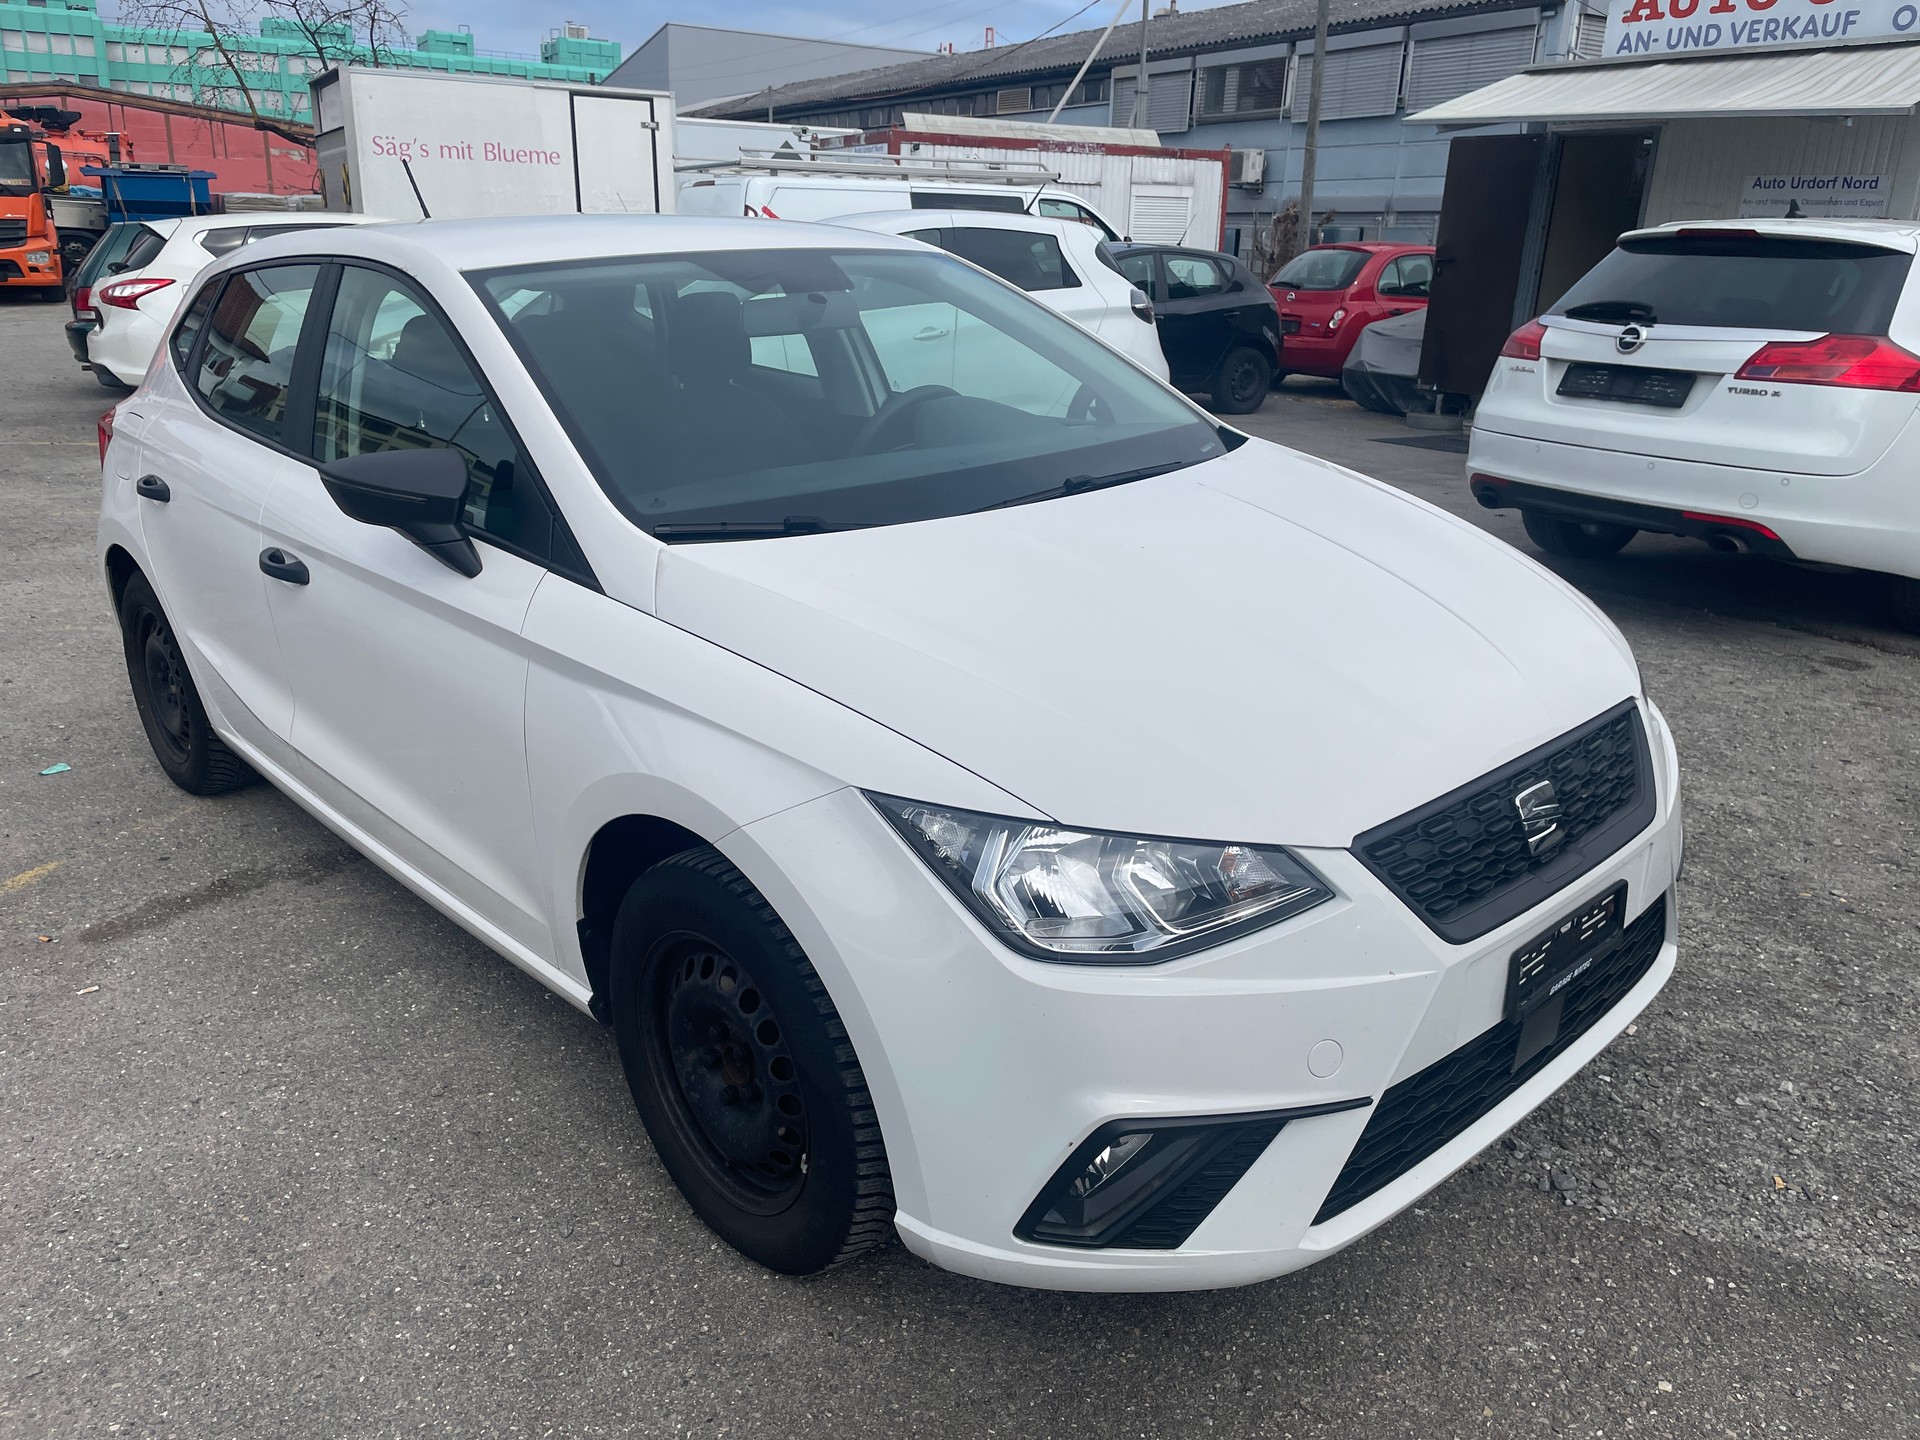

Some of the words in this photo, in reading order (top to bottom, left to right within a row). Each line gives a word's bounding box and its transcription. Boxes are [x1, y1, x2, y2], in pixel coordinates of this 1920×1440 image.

[1616, 29, 1659, 54] AN-
[1666, 23, 1722, 50] UND
[1730, 9, 1861, 44] VERKAUF
[1892, 4, 1920, 31] O
[439, 141, 475, 161] mit
[484, 142, 561, 166] Blueme
[1752, 176, 1786, 190] Auto
[1791, 176, 1839, 190] Urdorf
[1841, 176, 1880, 190] Nord
[1860, 199, 1884, 207] Export
[1727, 386, 1769, 397] TURBO
